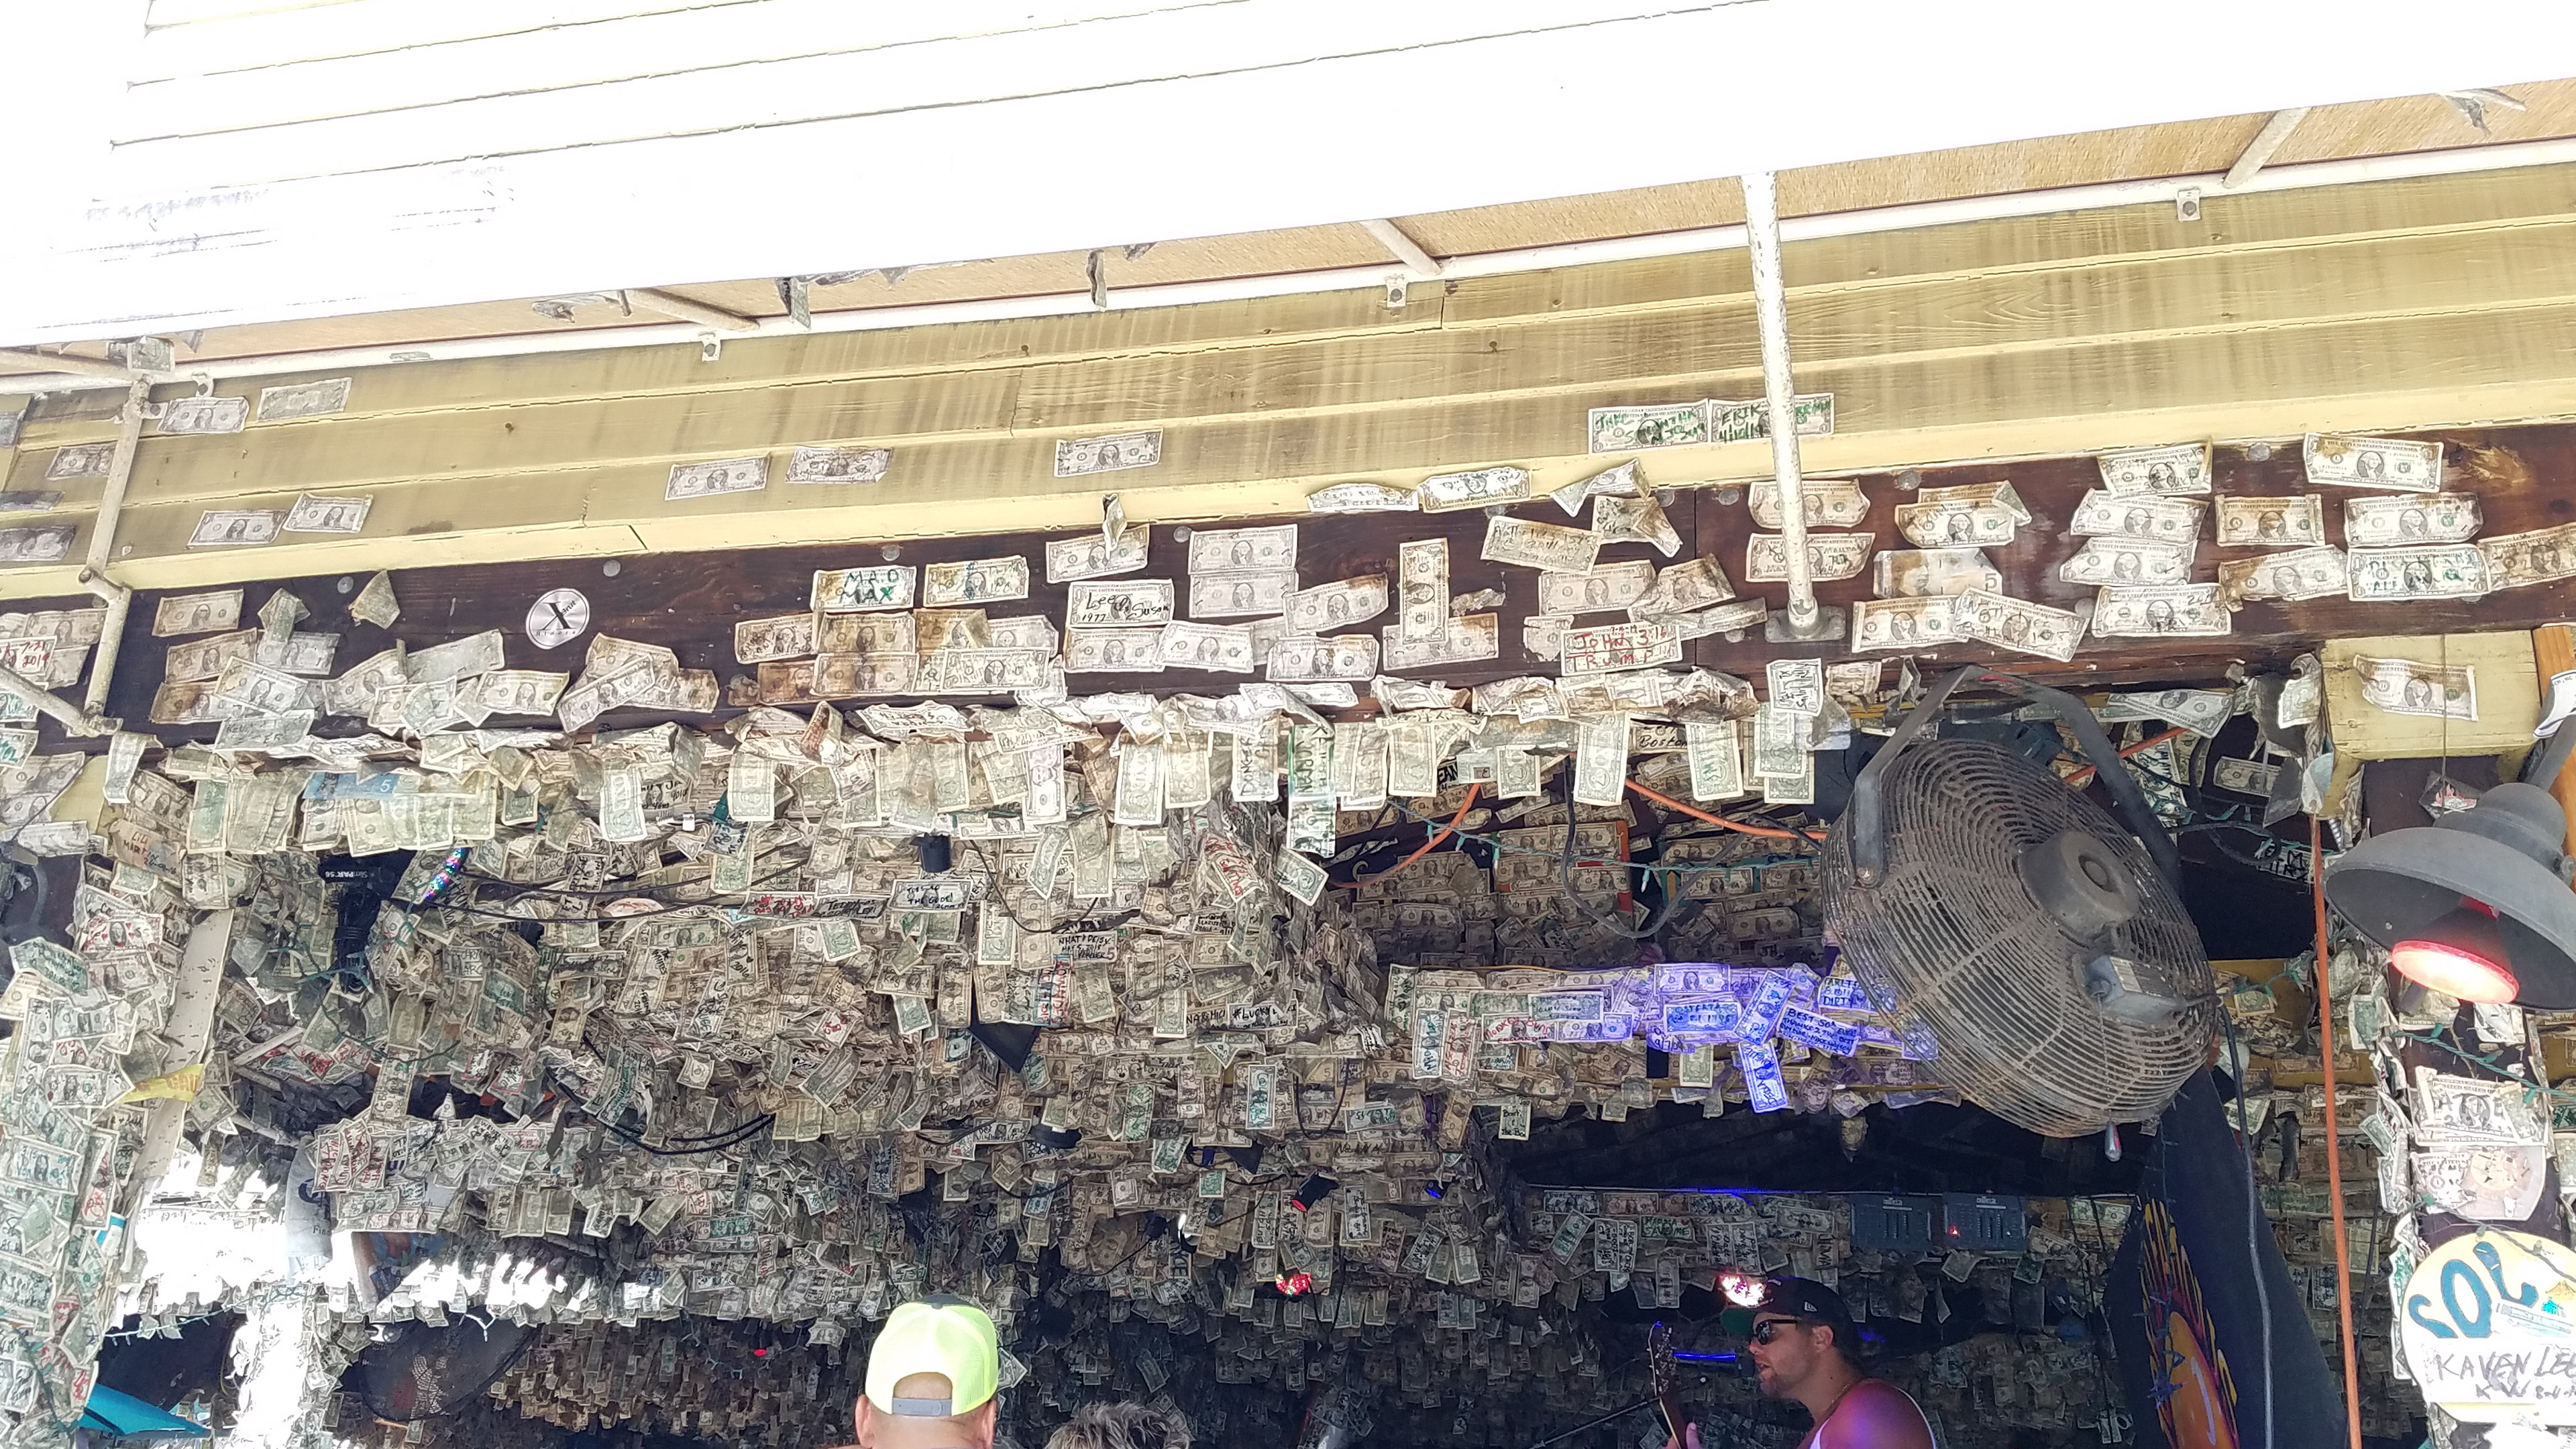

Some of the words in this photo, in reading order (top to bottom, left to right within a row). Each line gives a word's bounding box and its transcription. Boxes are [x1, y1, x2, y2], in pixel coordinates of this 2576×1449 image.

[1984, 573, 1998, 590] 5
[839, 584, 895, 604] MAX
[1574, 632, 1625, 650] JOHN
[22, 652, 51, 669] 2019
[380, 779, 392, 793] 5
[1107, 947, 1116, 960] 5
[939, 1099, 963, 1118] Bad
[969, 1097, 991, 1110] Axe
